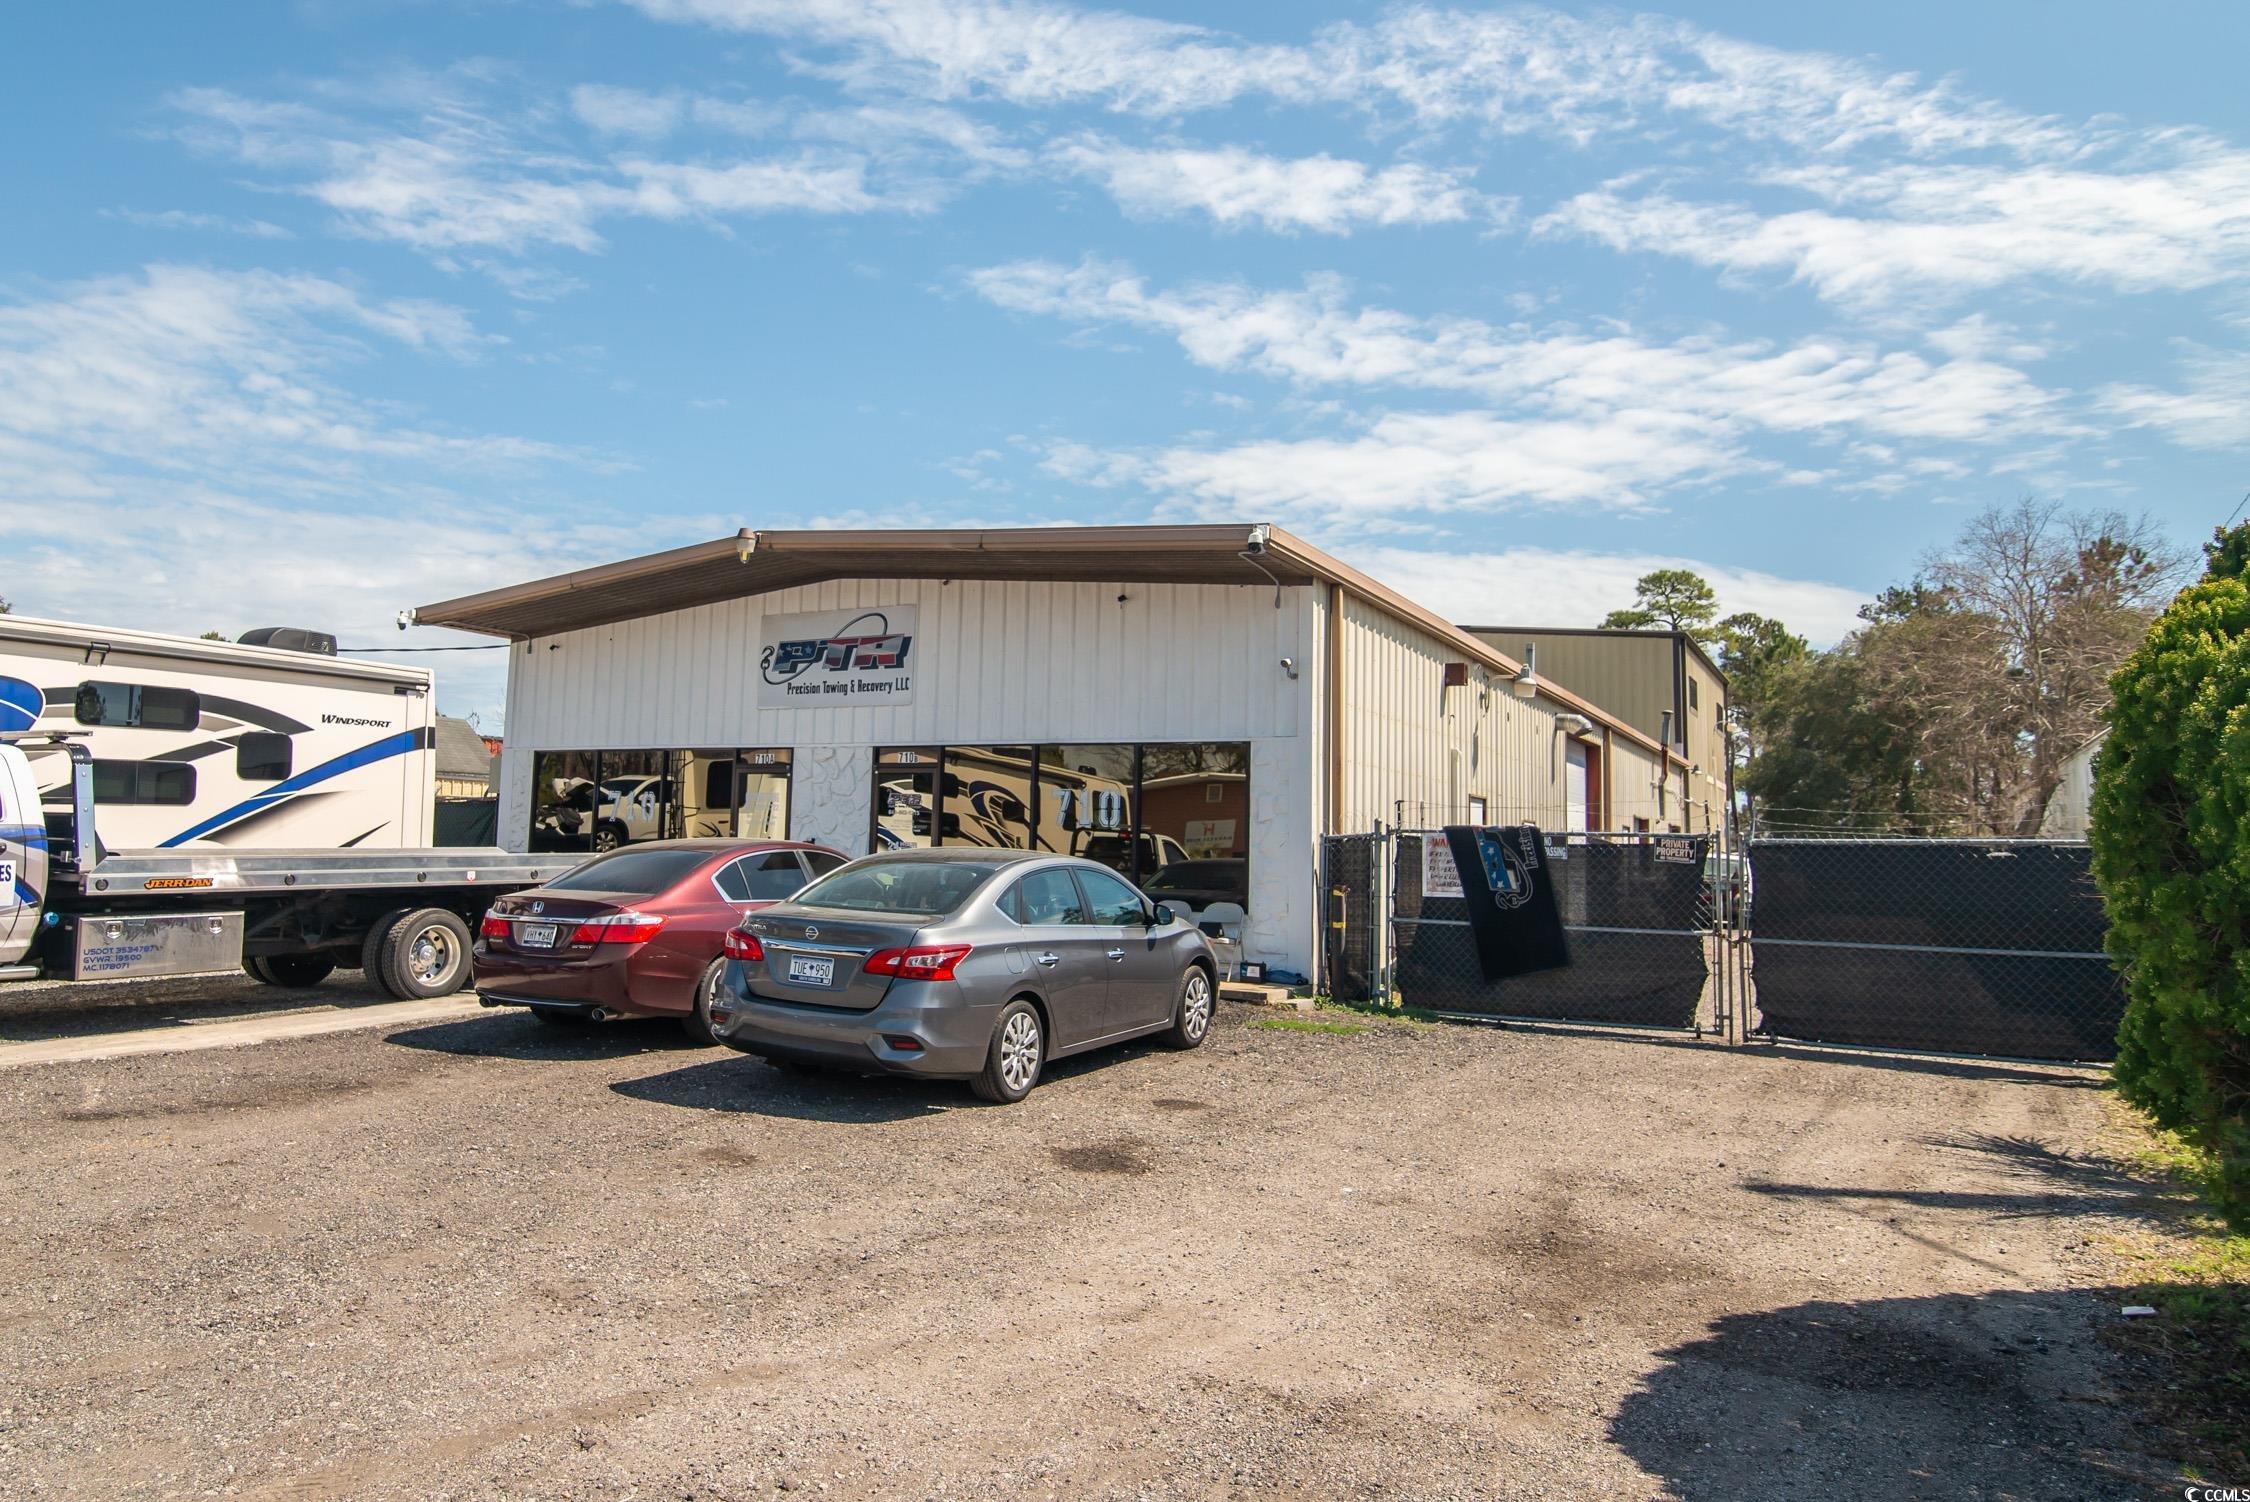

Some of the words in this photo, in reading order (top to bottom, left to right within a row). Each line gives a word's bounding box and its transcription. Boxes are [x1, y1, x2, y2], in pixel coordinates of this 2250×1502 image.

[772, 633, 912, 674] PTR
[787, 682, 821, 695] Precision
[823, 680, 848, 696] Towing
[850, 679, 856, 693] &
[858, 678, 893, 694] Recovery
[896, 677, 910, 691] LLC
[321, 714, 391, 728] WINDSPORT
[755, 753, 775, 764] 710A
[608, 790, 657, 822] 710
[1052, 788, 1121, 829] 710
[1544, 836, 1552, 846] NO
[1661, 839, 1690, 849] PRIVATE
[1657, 847, 1694, 858] PROPERTY
[145, 878, 213, 889] JERR-DAN
[794, 961, 808, 975] TUE
[816, 963, 831, 977] 950
